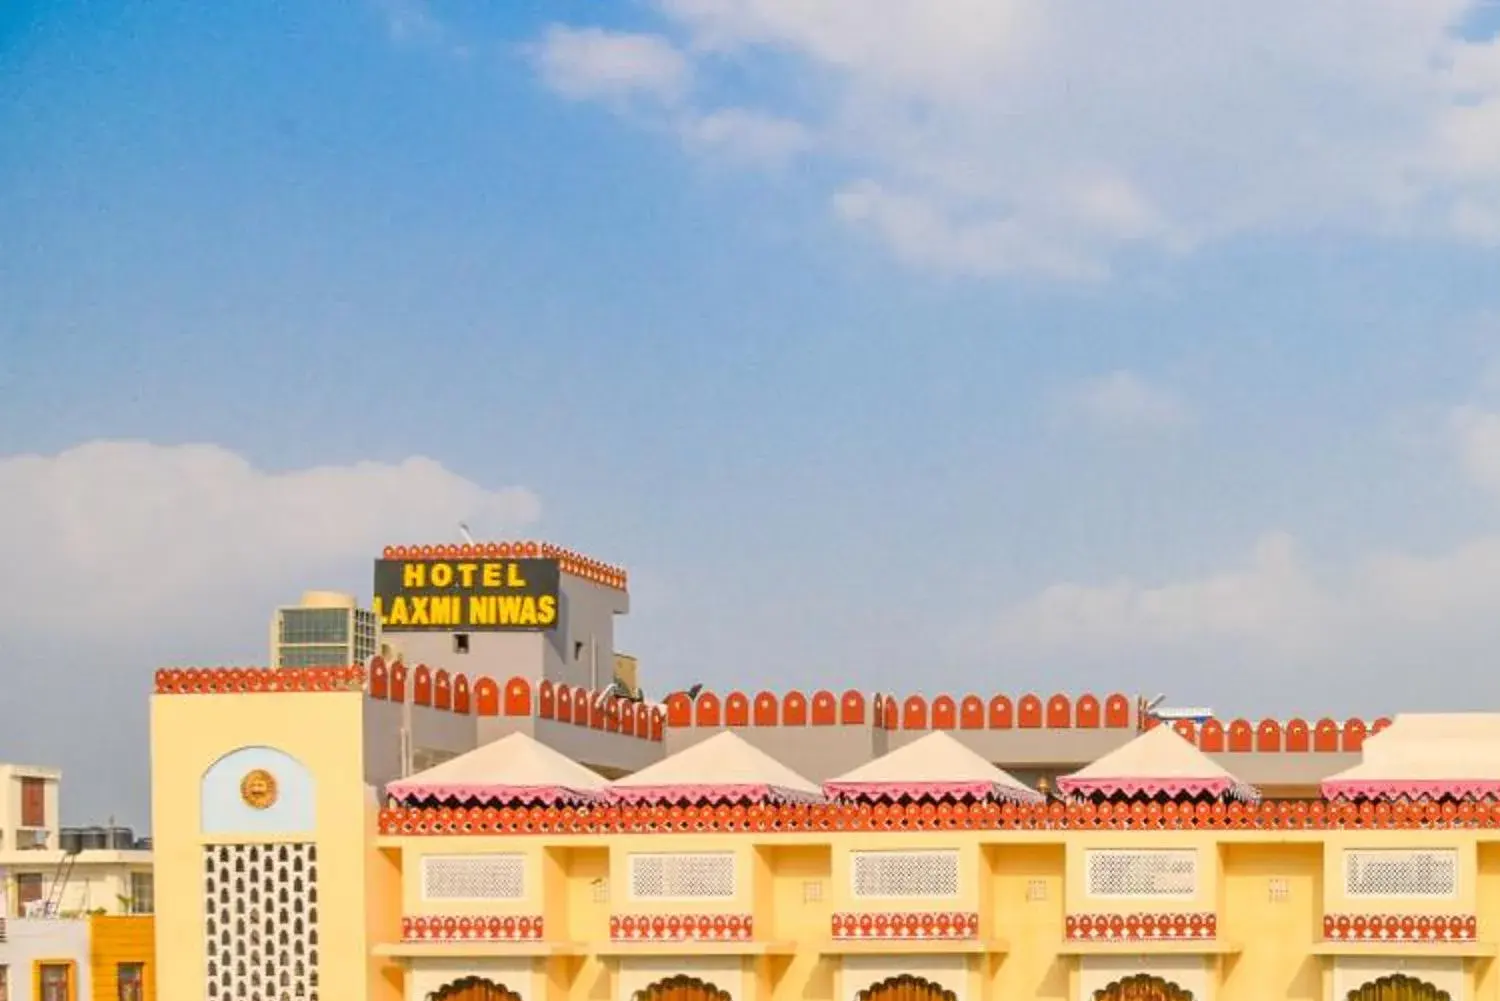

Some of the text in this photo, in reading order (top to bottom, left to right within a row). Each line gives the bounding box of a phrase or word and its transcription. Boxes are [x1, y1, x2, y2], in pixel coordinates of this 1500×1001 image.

[403, 562, 526, 588] HOTEL
[373, 594, 556, 625] LAXMI NIWAS
